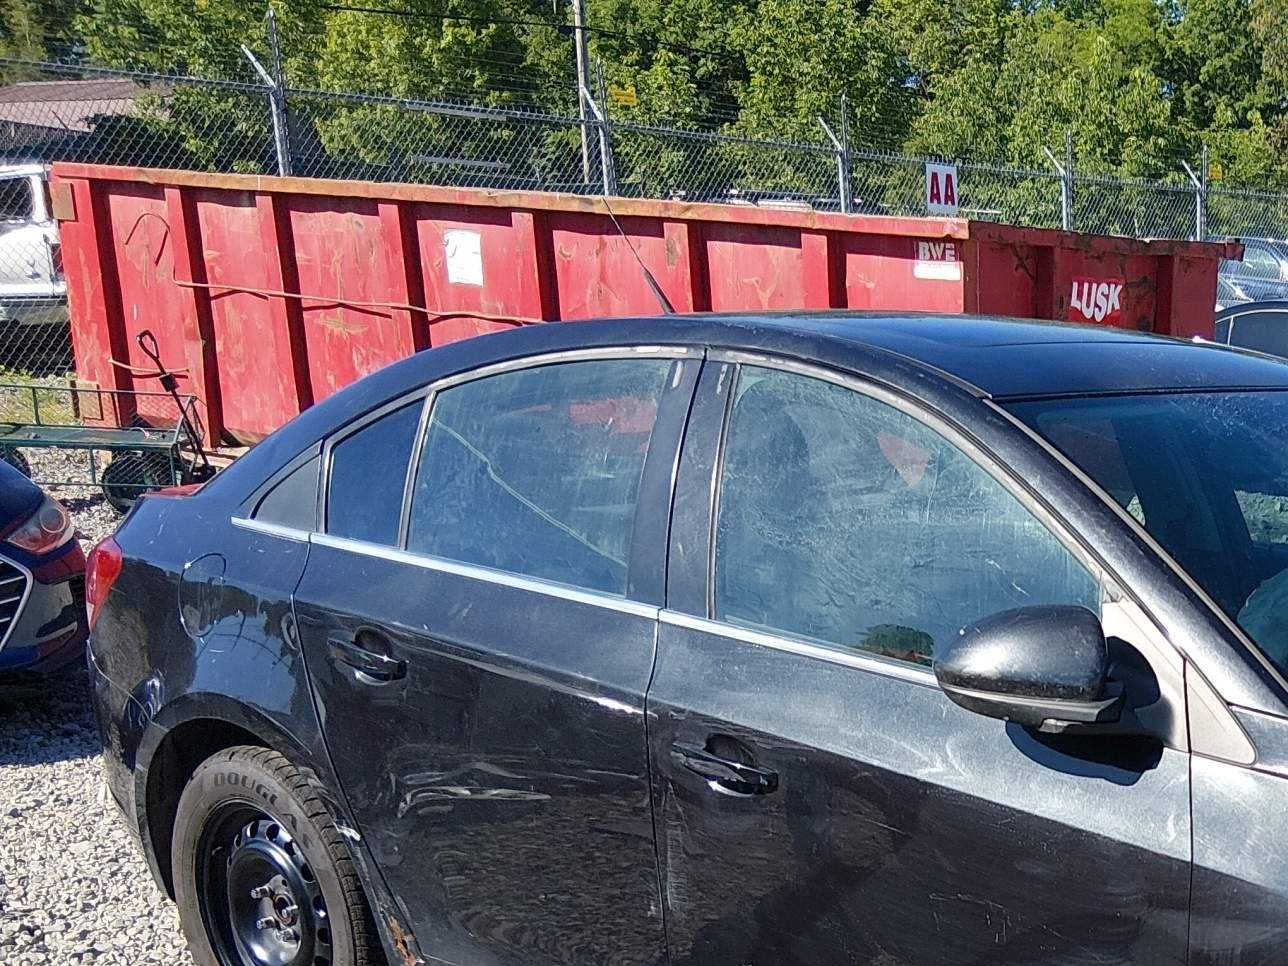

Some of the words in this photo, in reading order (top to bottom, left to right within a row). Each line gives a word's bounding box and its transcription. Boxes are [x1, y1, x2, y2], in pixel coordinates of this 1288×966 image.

[929, 171, 956, 206] AA
[918, 241, 956, 262] BWE
[1070, 281, 1123, 322] LUSK
